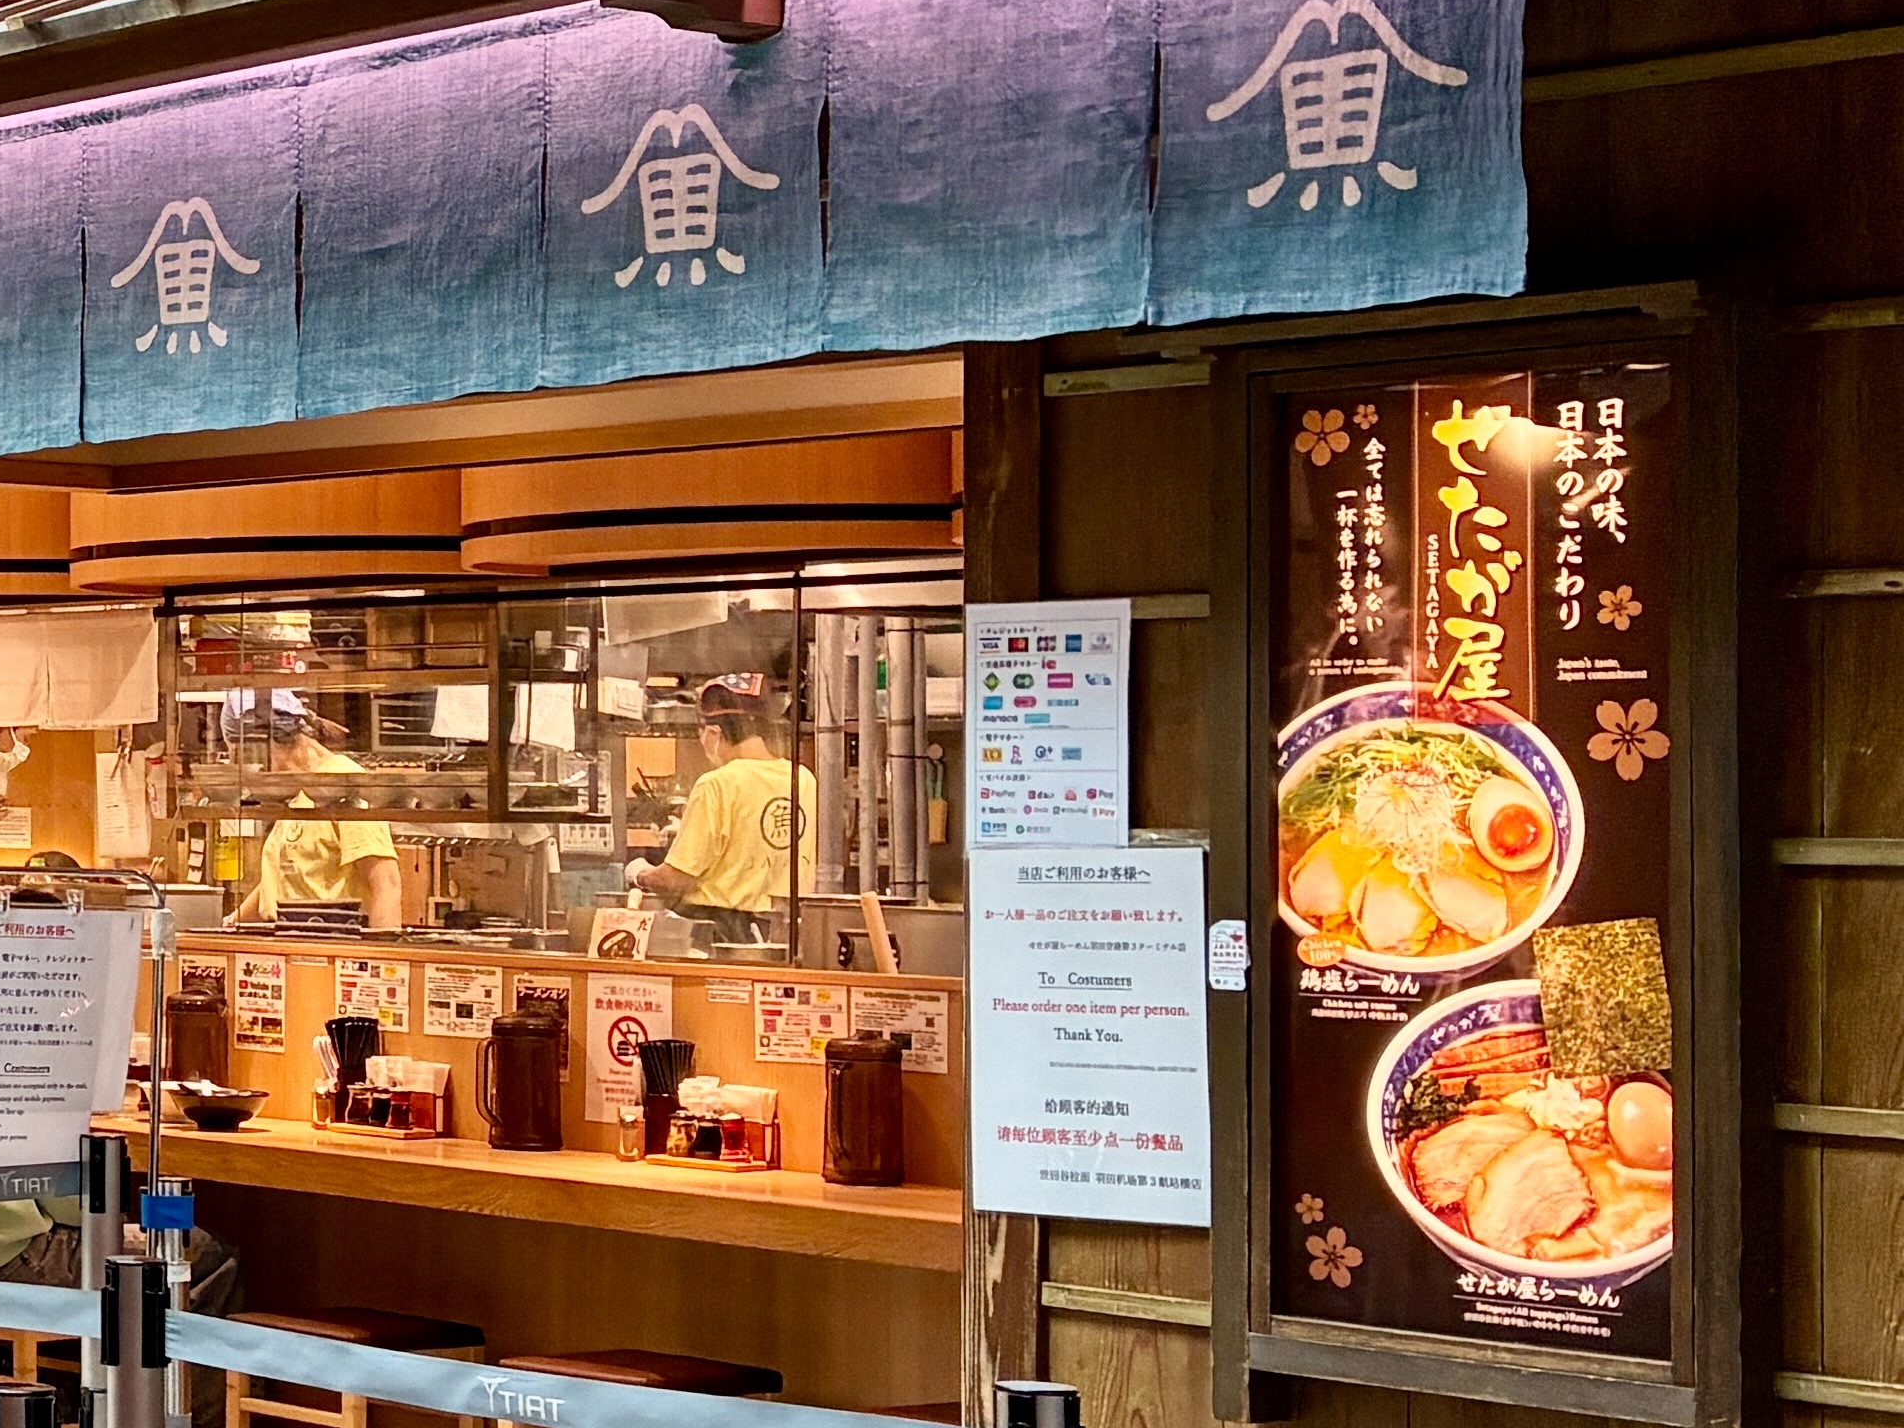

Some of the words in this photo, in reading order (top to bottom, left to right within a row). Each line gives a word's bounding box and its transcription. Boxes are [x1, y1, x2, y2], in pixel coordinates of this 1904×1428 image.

[1592, 398, 1627, 543] 日本の味、
[1553, 401, 1586, 630] 日本のこだわり
[1363, 437, 1385, 632] 全ては忘れられない
[1432, 399, 1523, 701] せたが屋
[1426, 534, 1440, 669] SETAGAYA
[1018, 866, 1151, 881] 当店ご利用のお客様へ
[1038, 972, 1055, 984] To
[1068, 973, 1132, 986] Costumers
[1299, 968, 1420, 995] 鶏塩らーめん
[993, 998, 1029, 1012] Please
[1032, 1000, 1061, 1012] order
[1066, 1003, 1087, 1013] one
[1090, 1001, 1116, 1014] item
[1121, 1004, 1140, 1017] per
[1144, 1006, 1190, 1019] person.
[1054, 1028, 1092, 1041] Thank
[1096, 1030, 1123, 1043] You.
[1045, 1099, 1129, 1116] 给顾客的通知
[10, 1176, 52, 1194] TIAT
[1456, 1273, 1620, 1308] せたが屋らーめん
[498, 1390, 565, 1422] TIAT
